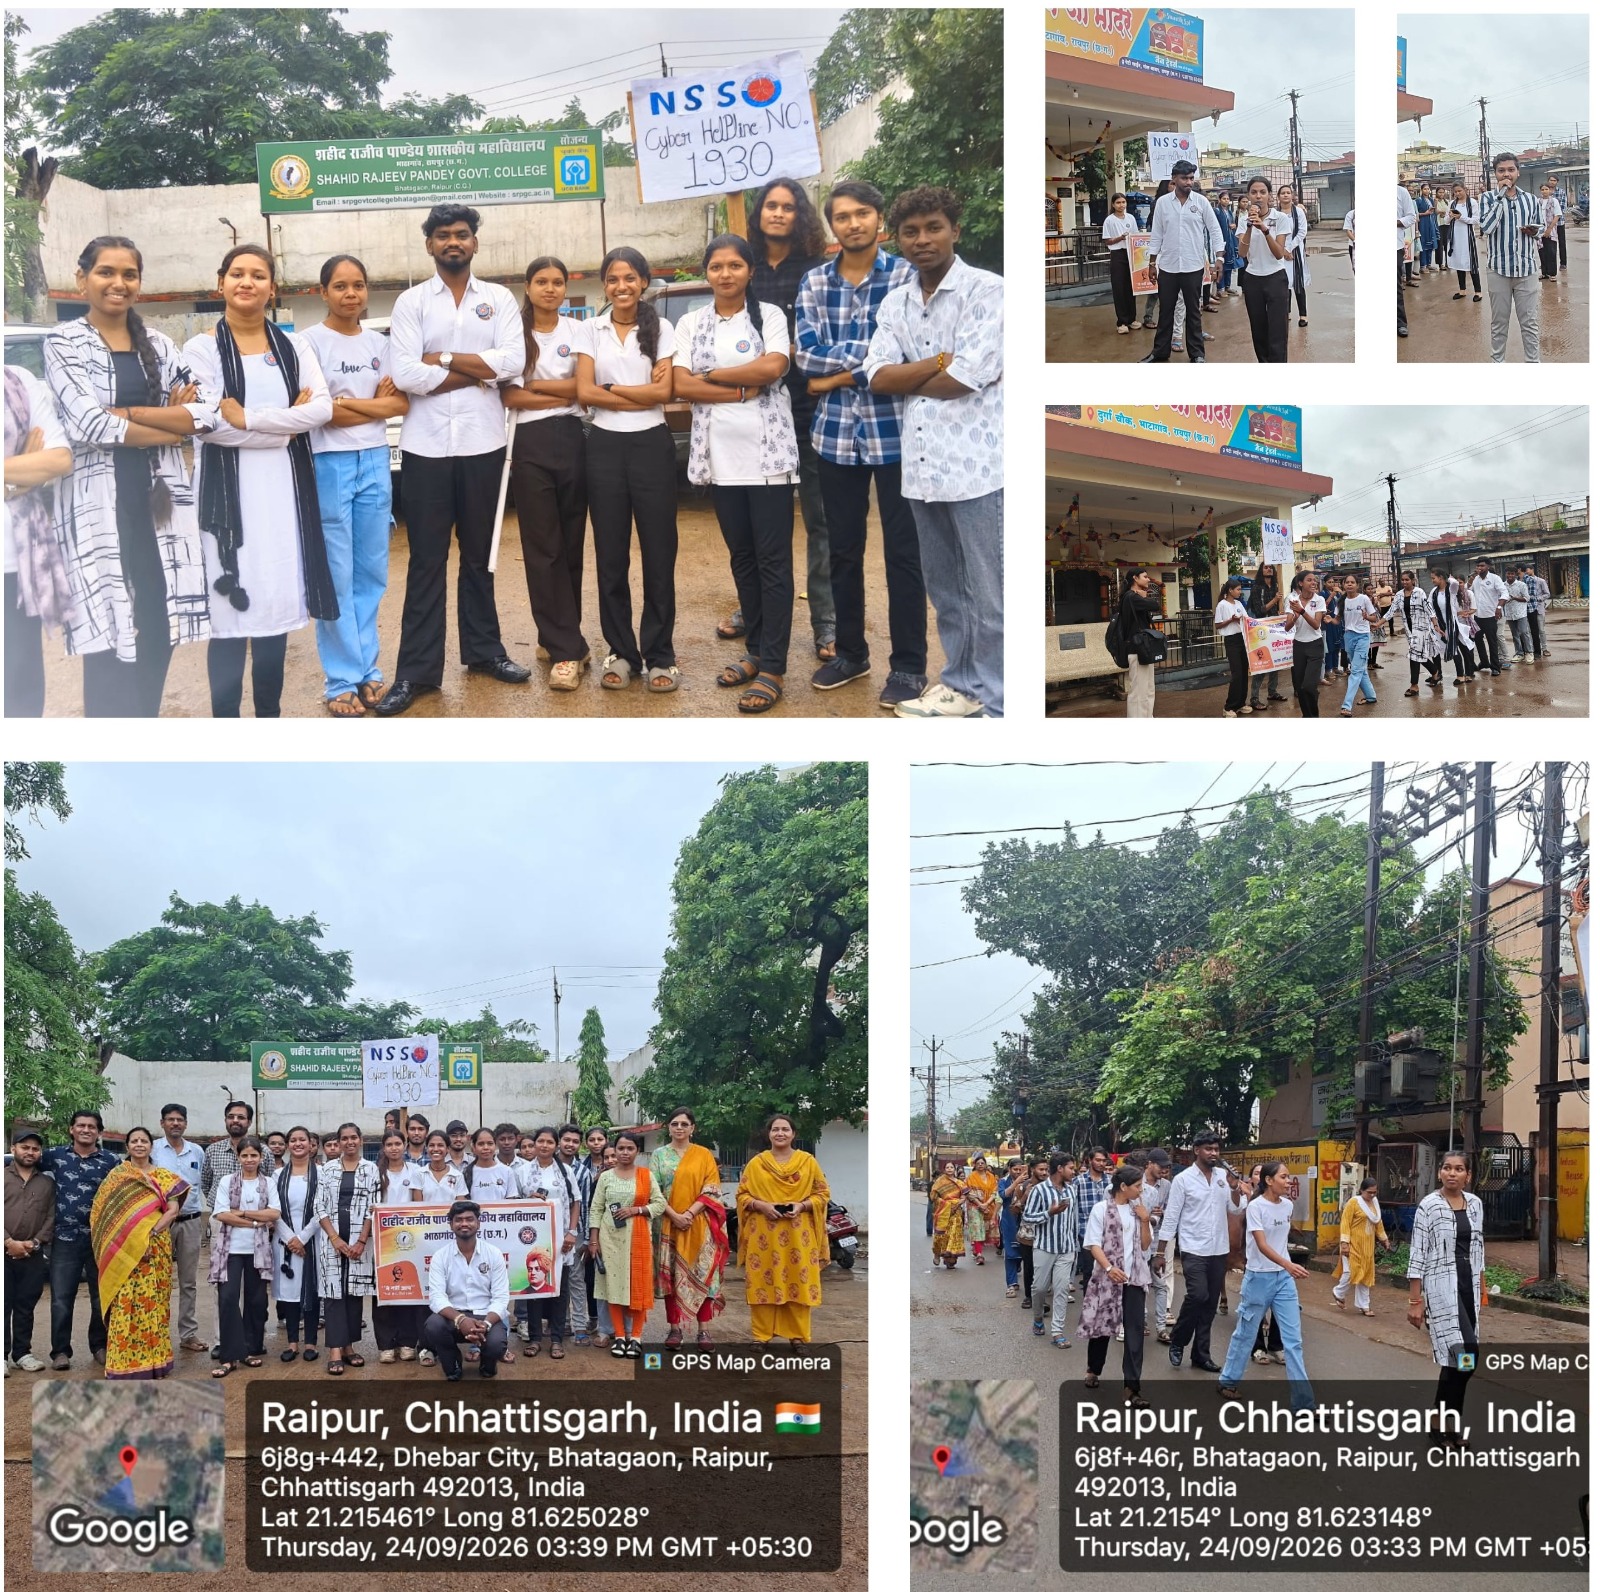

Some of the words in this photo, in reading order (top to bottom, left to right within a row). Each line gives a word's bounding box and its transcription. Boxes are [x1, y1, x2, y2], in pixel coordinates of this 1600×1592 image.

[315, 146, 346, 161] शहीद
[350, 144, 384, 159] राजीव
[386, 142, 424, 158] पाण्डेय
[427, 140, 475, 157] शासकीय
[478, 138, 546, 155] महाविद्यालय
[645, 126, 692, 160] Cyber
[316, 173, 360, 186] SHAHID
[363, 171, 407, 184] RAJEEV
[410, 169, 455, 182] PANDEY
[458, 167, 491, 180] GOVT.
[494, 165, 547, 178] COLLEGE
[684, 141, 774, 190] 1930
[316, 198, 336, 206] Email
[479, 192, 506, 200] Website
[512, 190, 550, 199] srpgc.ac.in
[431, 184, 452, 192] Raipur
[1097, 409, 1113, 423] दुर्गा
[1115, 412, 1137, 429] चौक,
[1173, 427, 1192, 442] रायपुर
[290, 1064, 319, 1073] SHAHID
[321, 1064, 351, 1073] RAJEEV
[383, 1081, 422, 1103] 1930
[382, 1214, 405, 1227] शहीद
[406, 1213, 431, 1226] राजीव
[498, 1210, 546, 1223] महाविद्यालय
